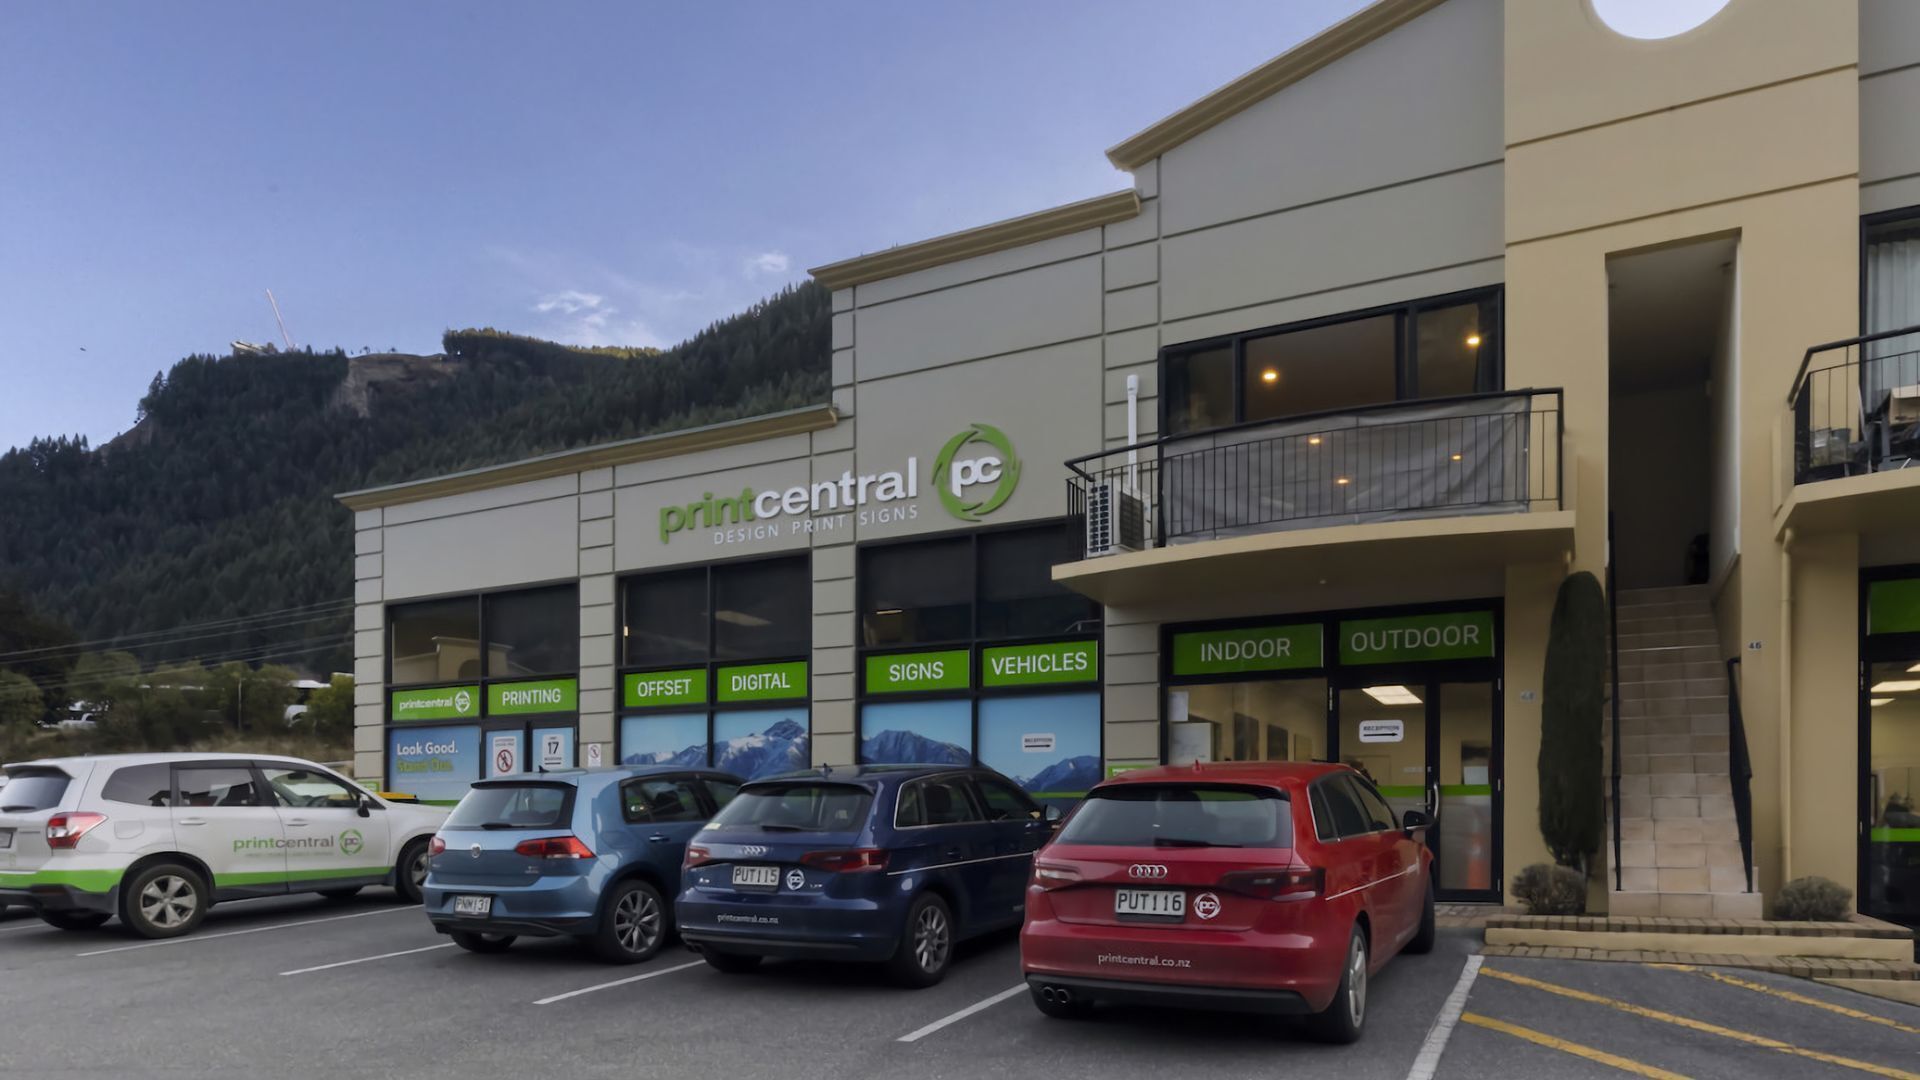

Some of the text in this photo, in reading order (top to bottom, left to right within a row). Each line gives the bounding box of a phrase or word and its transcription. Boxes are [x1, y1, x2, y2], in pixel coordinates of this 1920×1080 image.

[951, 455, 1002, 498] pc
[659, 457, 918, 544] printcentral
[714, 505, 918, 545] DESIGN PRINT SIGNS
[1201, 624, 1480, 662] INDOOR OUTDOOR
[888, 651, 1088, 682] SIGNS VEHICLES
[637, 672, 790, 697] OFFSET DIGITAL
[399, 697, 453, 712] printcentral
[502, 688, 561, 706] PRINTING
[397, 740, 458, 755] Look Good.
[547, 741, 559, 754] 17
[233, 835, 334, 852] printcentral
[734, 867, 778, 883] PUT115
[1118, 892, 1182, 912] PUT116
[1098, 953, 1191, 968] printcentral.co.nz
